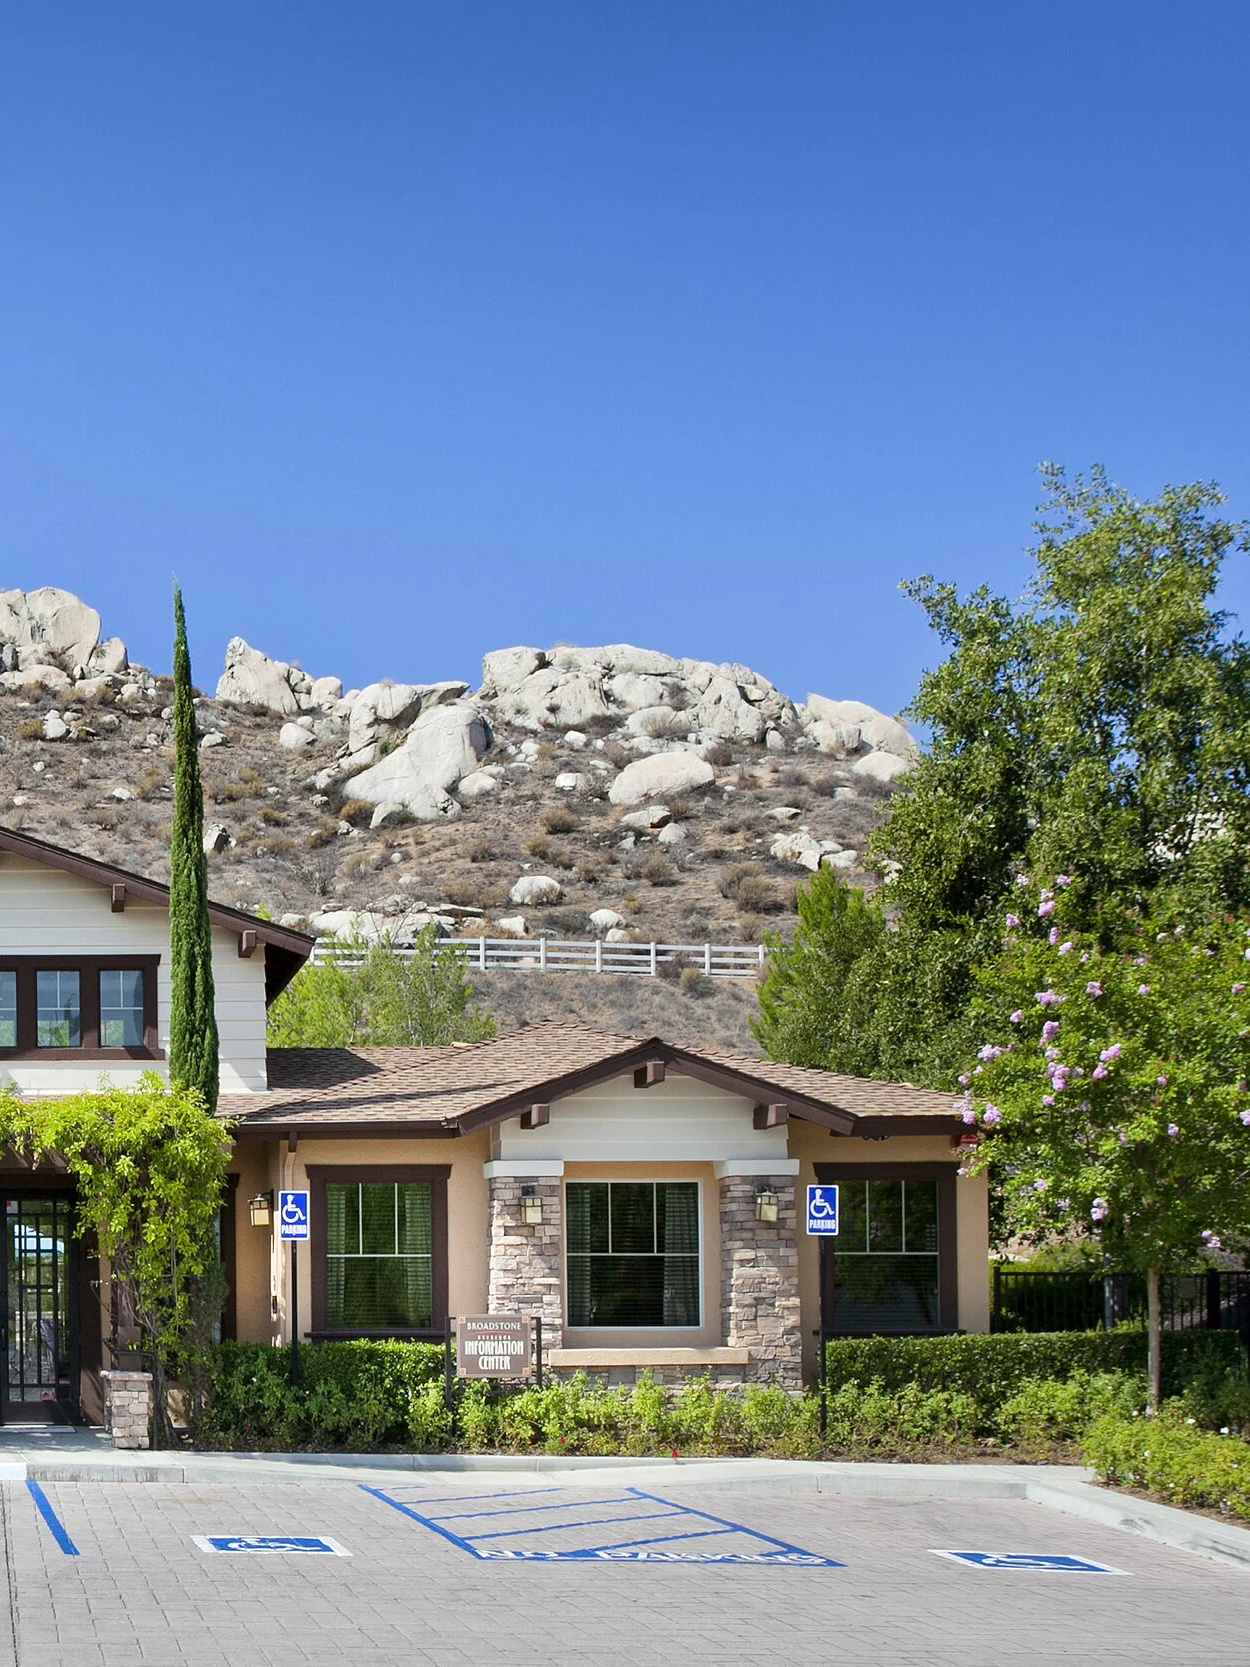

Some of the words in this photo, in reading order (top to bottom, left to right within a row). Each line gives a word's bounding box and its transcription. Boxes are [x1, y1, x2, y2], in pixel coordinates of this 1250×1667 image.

[809, 1219, 836, 1229] PARKING
[281, 1224, 307, 1235] PARKING
[466, 1322, 522, 1331] BROADSTONE
[464, 1340, 524, 1355] INFORMATION
[478, 1355, 511, 1370] CENTER
[475, 1549, 559, 1559] NO
